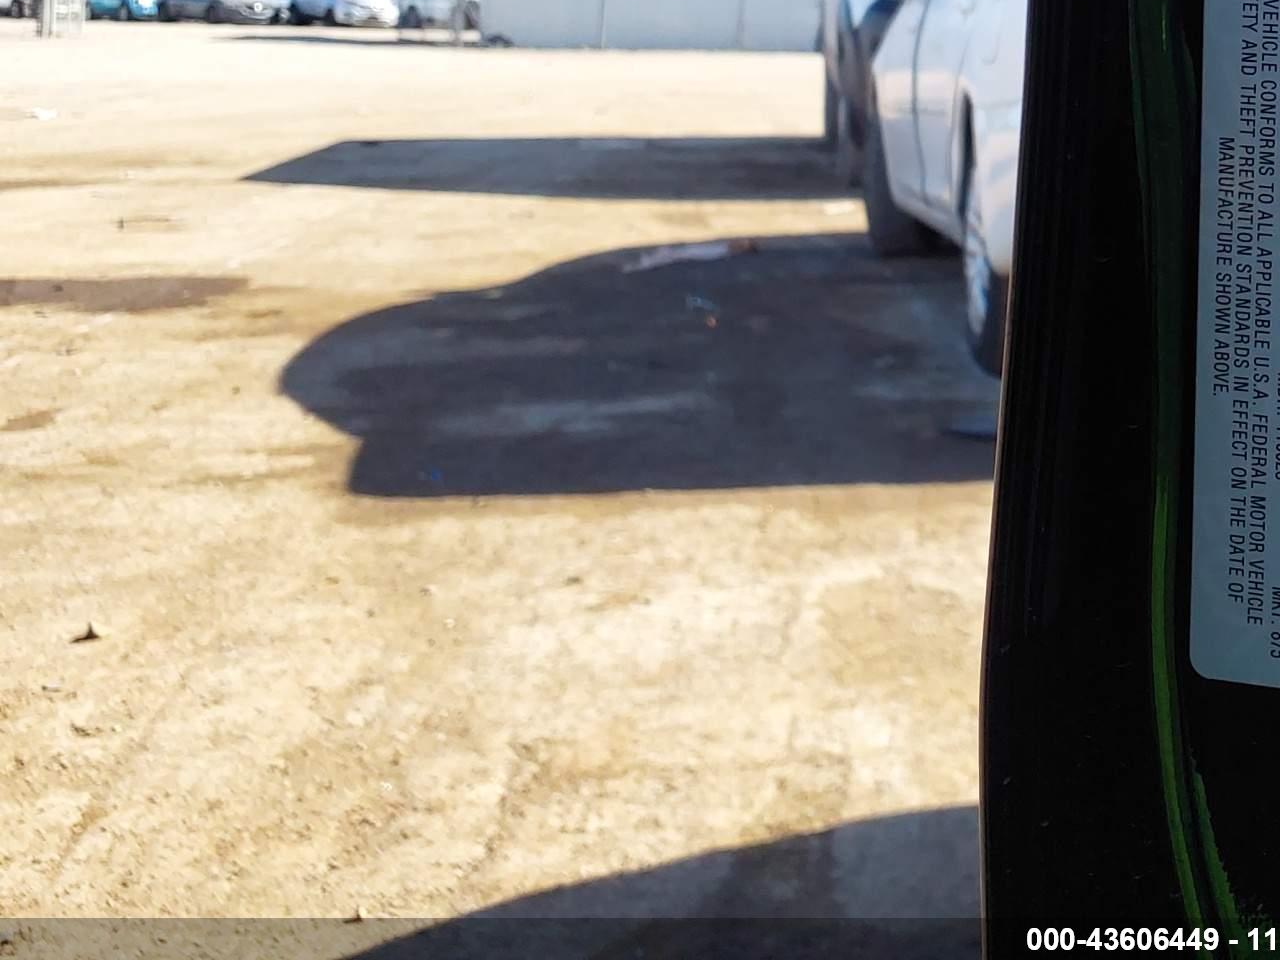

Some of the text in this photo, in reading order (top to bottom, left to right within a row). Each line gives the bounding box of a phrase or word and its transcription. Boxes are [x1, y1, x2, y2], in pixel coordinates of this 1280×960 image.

[1241, 40, 1258, 76] AND
[1261, 0, 1280, 72] VEHICLE
[1240, 84, 1256, 138] THEFT
[1257, 80, 1277, 176] CONFORMS
[1236, 145, 1255, 256] PREVENTION
[1258, 182, 1274, 204] TO
[1257, 210, 1274, 242] ALL
[1213, 137, 1236, 396] MANUFACTURE SHOWN ABOVE.
[1234, 264, 1252, 368] STANDARDS
[1254, 246, 1272, 350] APPLICABLE
[1232, 376, 1249, 392] IN
[1252, 357, 1270, 405] U.S.A.
[1232, 400, 1248, 461] EFFECT
[1250, 414, 1268, 488] FEDERAL
[1231, 467, 1247, 490] ON
[1230, 496, 1246, 528] THE
[1248, 496, 1266, 552] MOTOR
[1229, 534, 1246, 577] DATE
[1228, 582, 1244, 603] OF
[1247, 560, 1264, 626] VEHICLE
